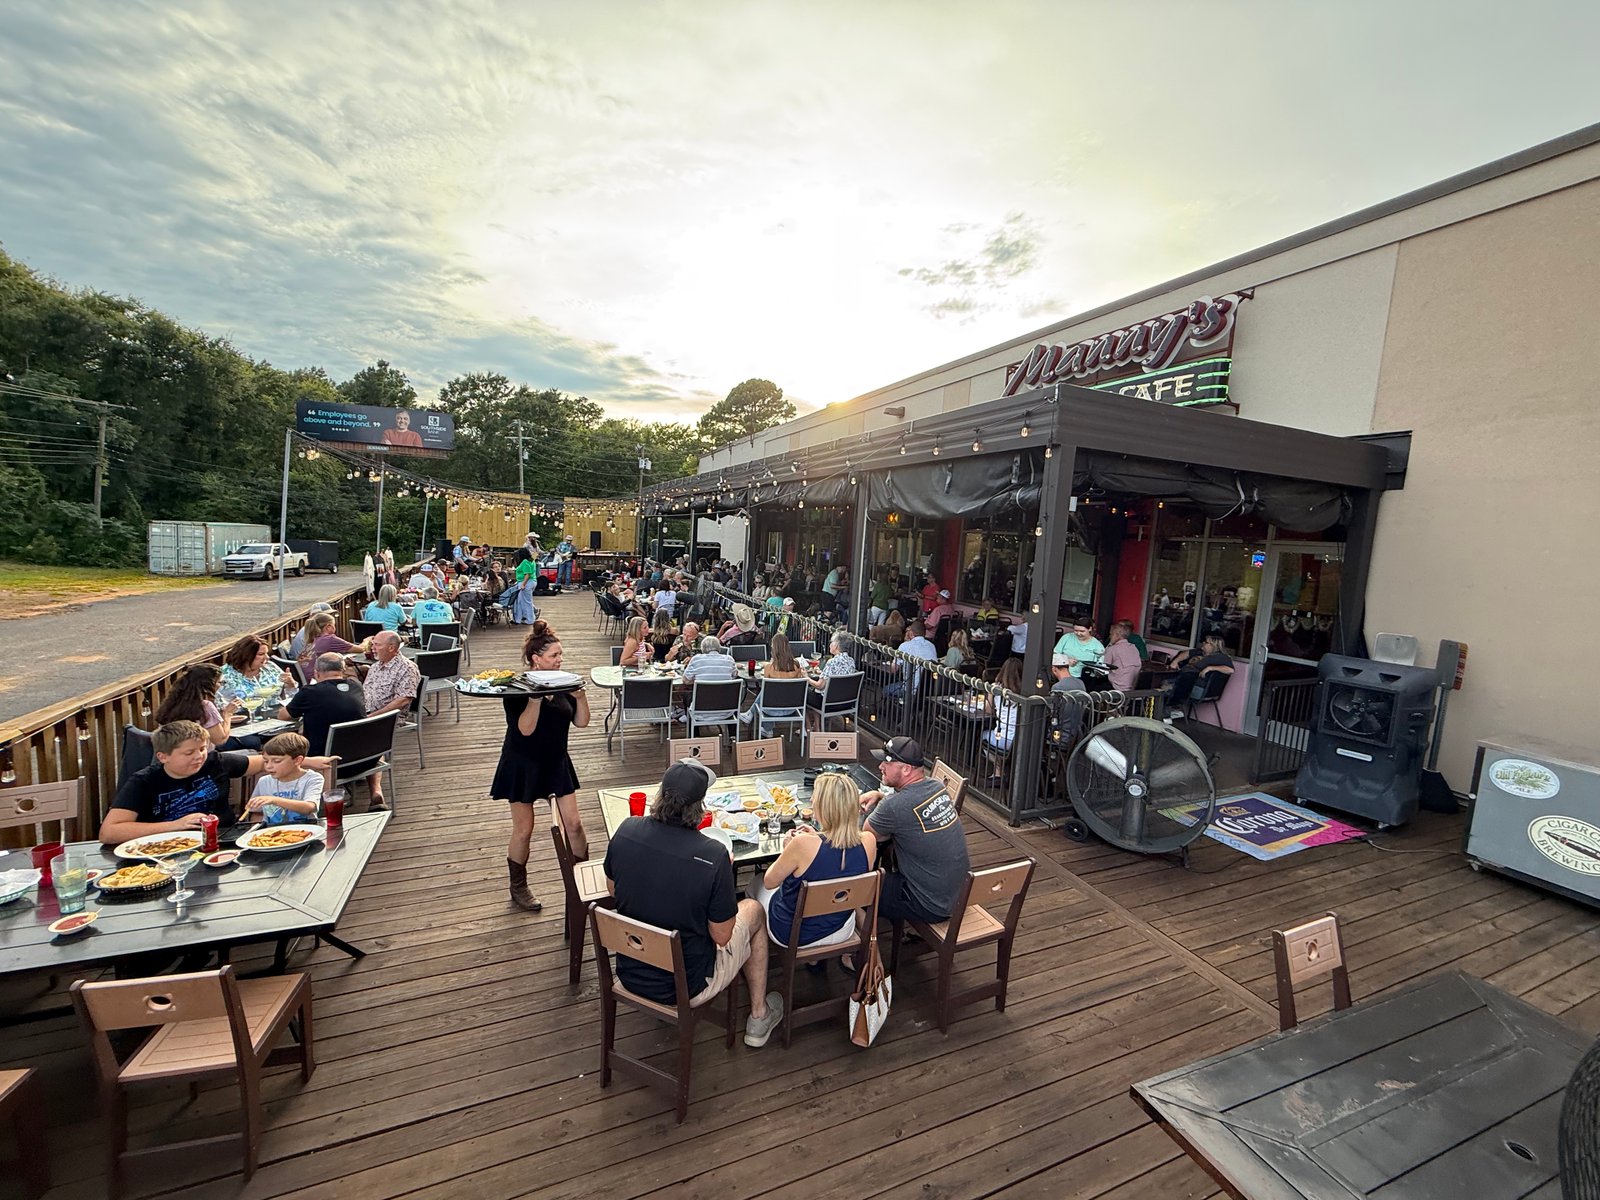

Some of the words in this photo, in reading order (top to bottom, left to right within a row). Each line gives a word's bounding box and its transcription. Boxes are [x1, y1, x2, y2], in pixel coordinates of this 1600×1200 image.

[1001, 294, 1239, 397] Manny's
[318, 410, 356, 419] Employees
[343, 419, 371, 428] beyond.
[1215, 811, 1299, 834] Corona
[1547, 820, 1588, 835] CIGAR
[1537, 839, 1600, 872] BREWING
